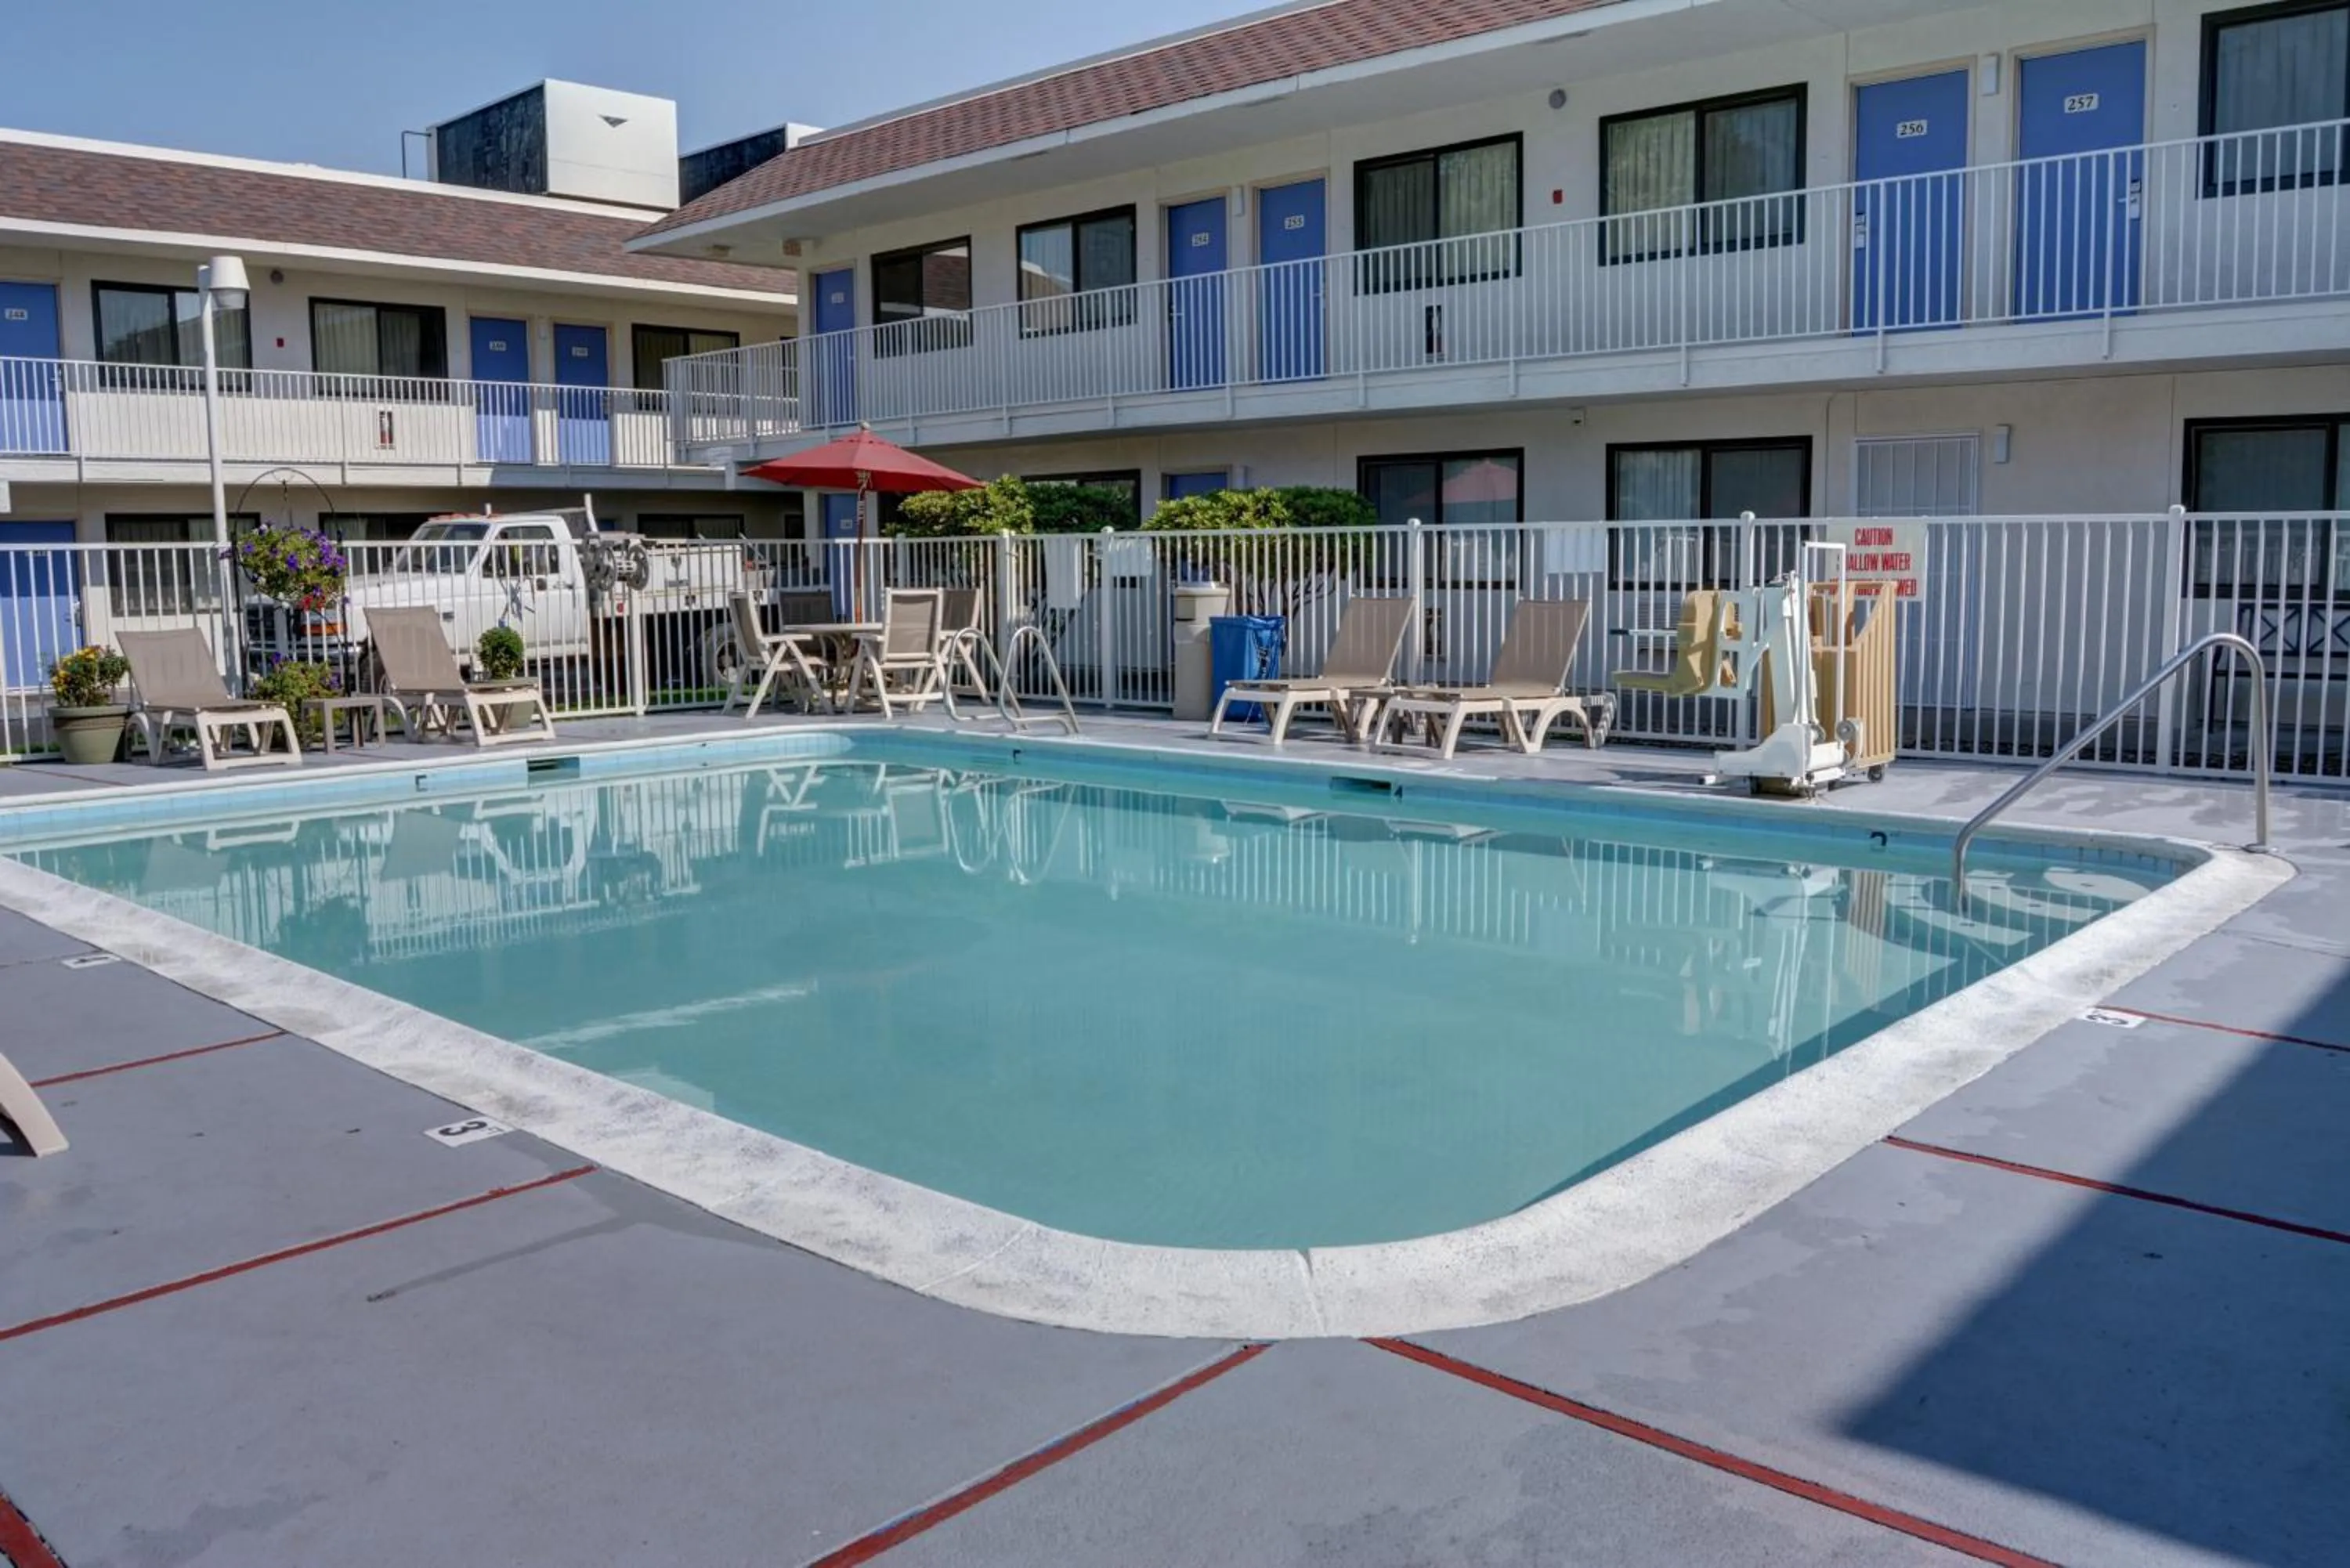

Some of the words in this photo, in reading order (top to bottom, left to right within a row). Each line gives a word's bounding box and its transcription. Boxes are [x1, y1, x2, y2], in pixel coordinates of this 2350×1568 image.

[2067, 95, 2094, 110] 257
[1854, 527, 1893, 545] CAUTION
[1836, 552, 1879, 571] ALLOW
[1881, 552, 1911, 571] WATER
[438, 1121, 488, 1136] 3
